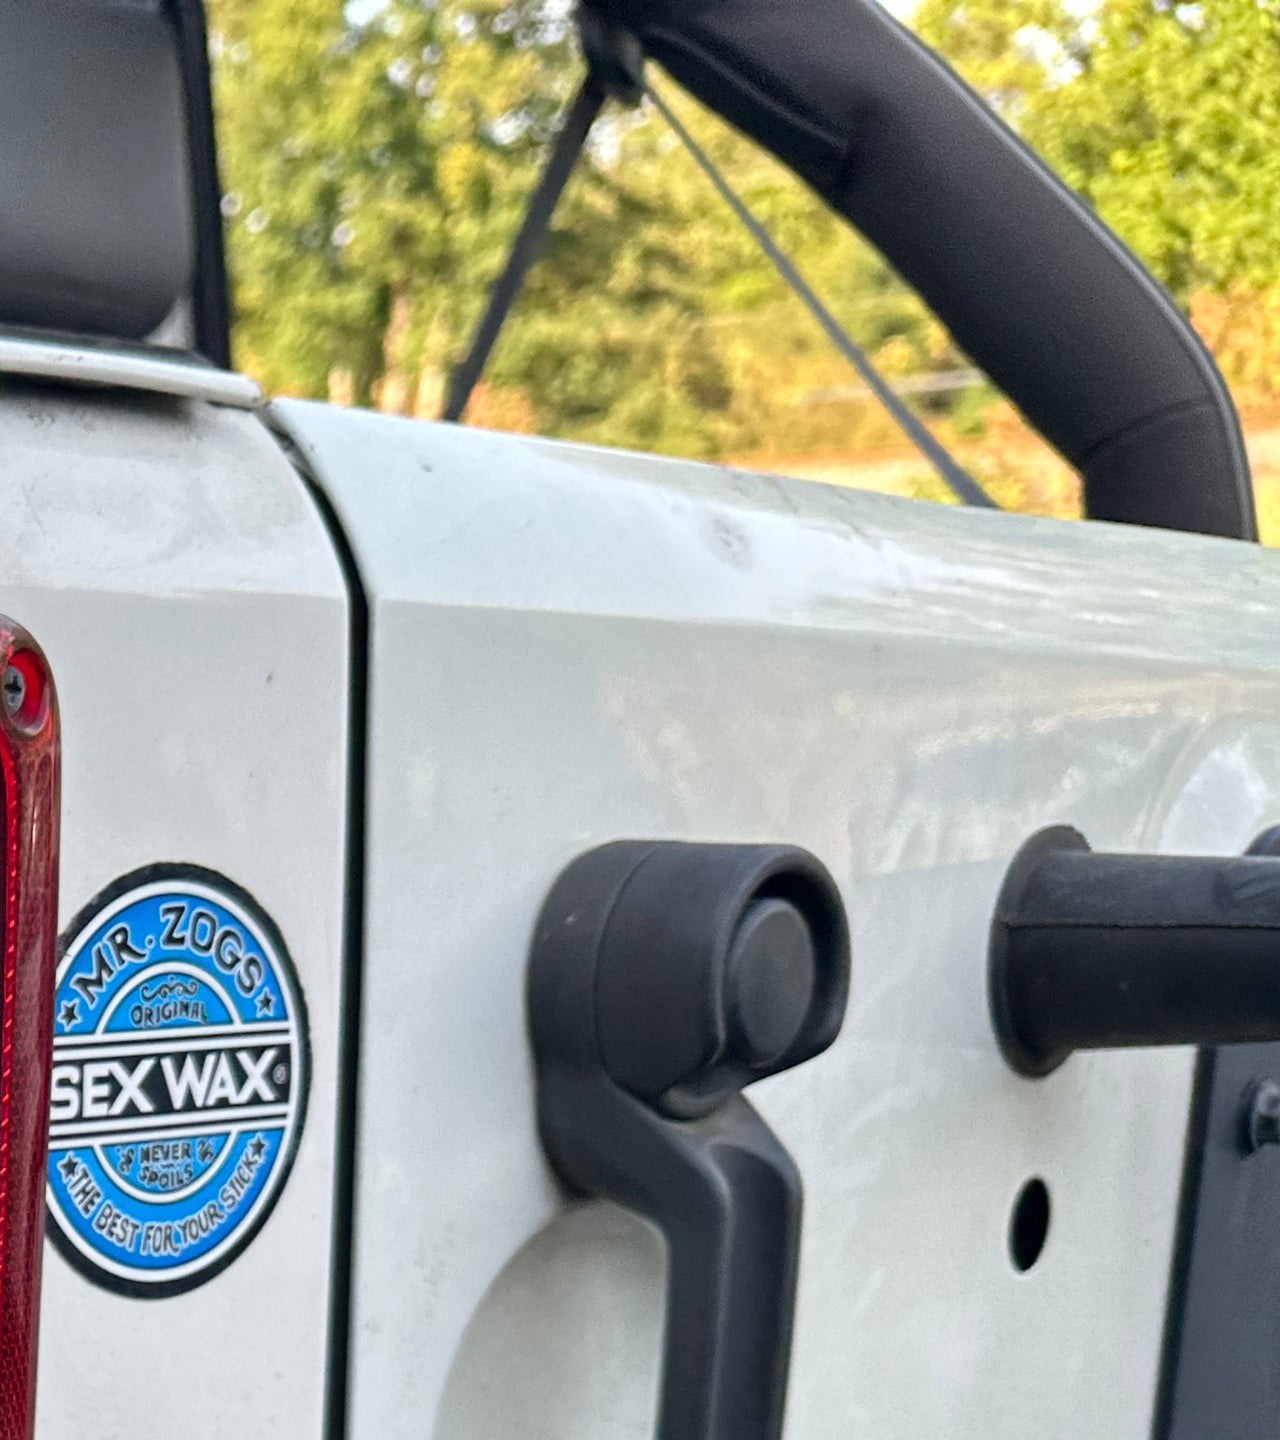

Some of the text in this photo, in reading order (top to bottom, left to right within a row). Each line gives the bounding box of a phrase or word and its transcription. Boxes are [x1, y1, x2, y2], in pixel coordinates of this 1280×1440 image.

[71, 904, 263, 1007] MR. ZOGS
[130, 1001, 209, 1028] ORIGINAL
[50, 1056, 157, 1121] SEX
[140, 1141, 193, 1163] NEVER
[139, 1164, 193, 1188] SPOILS
[69, 1152, 260, 1254] THE BEST FOR YOUR STICK
